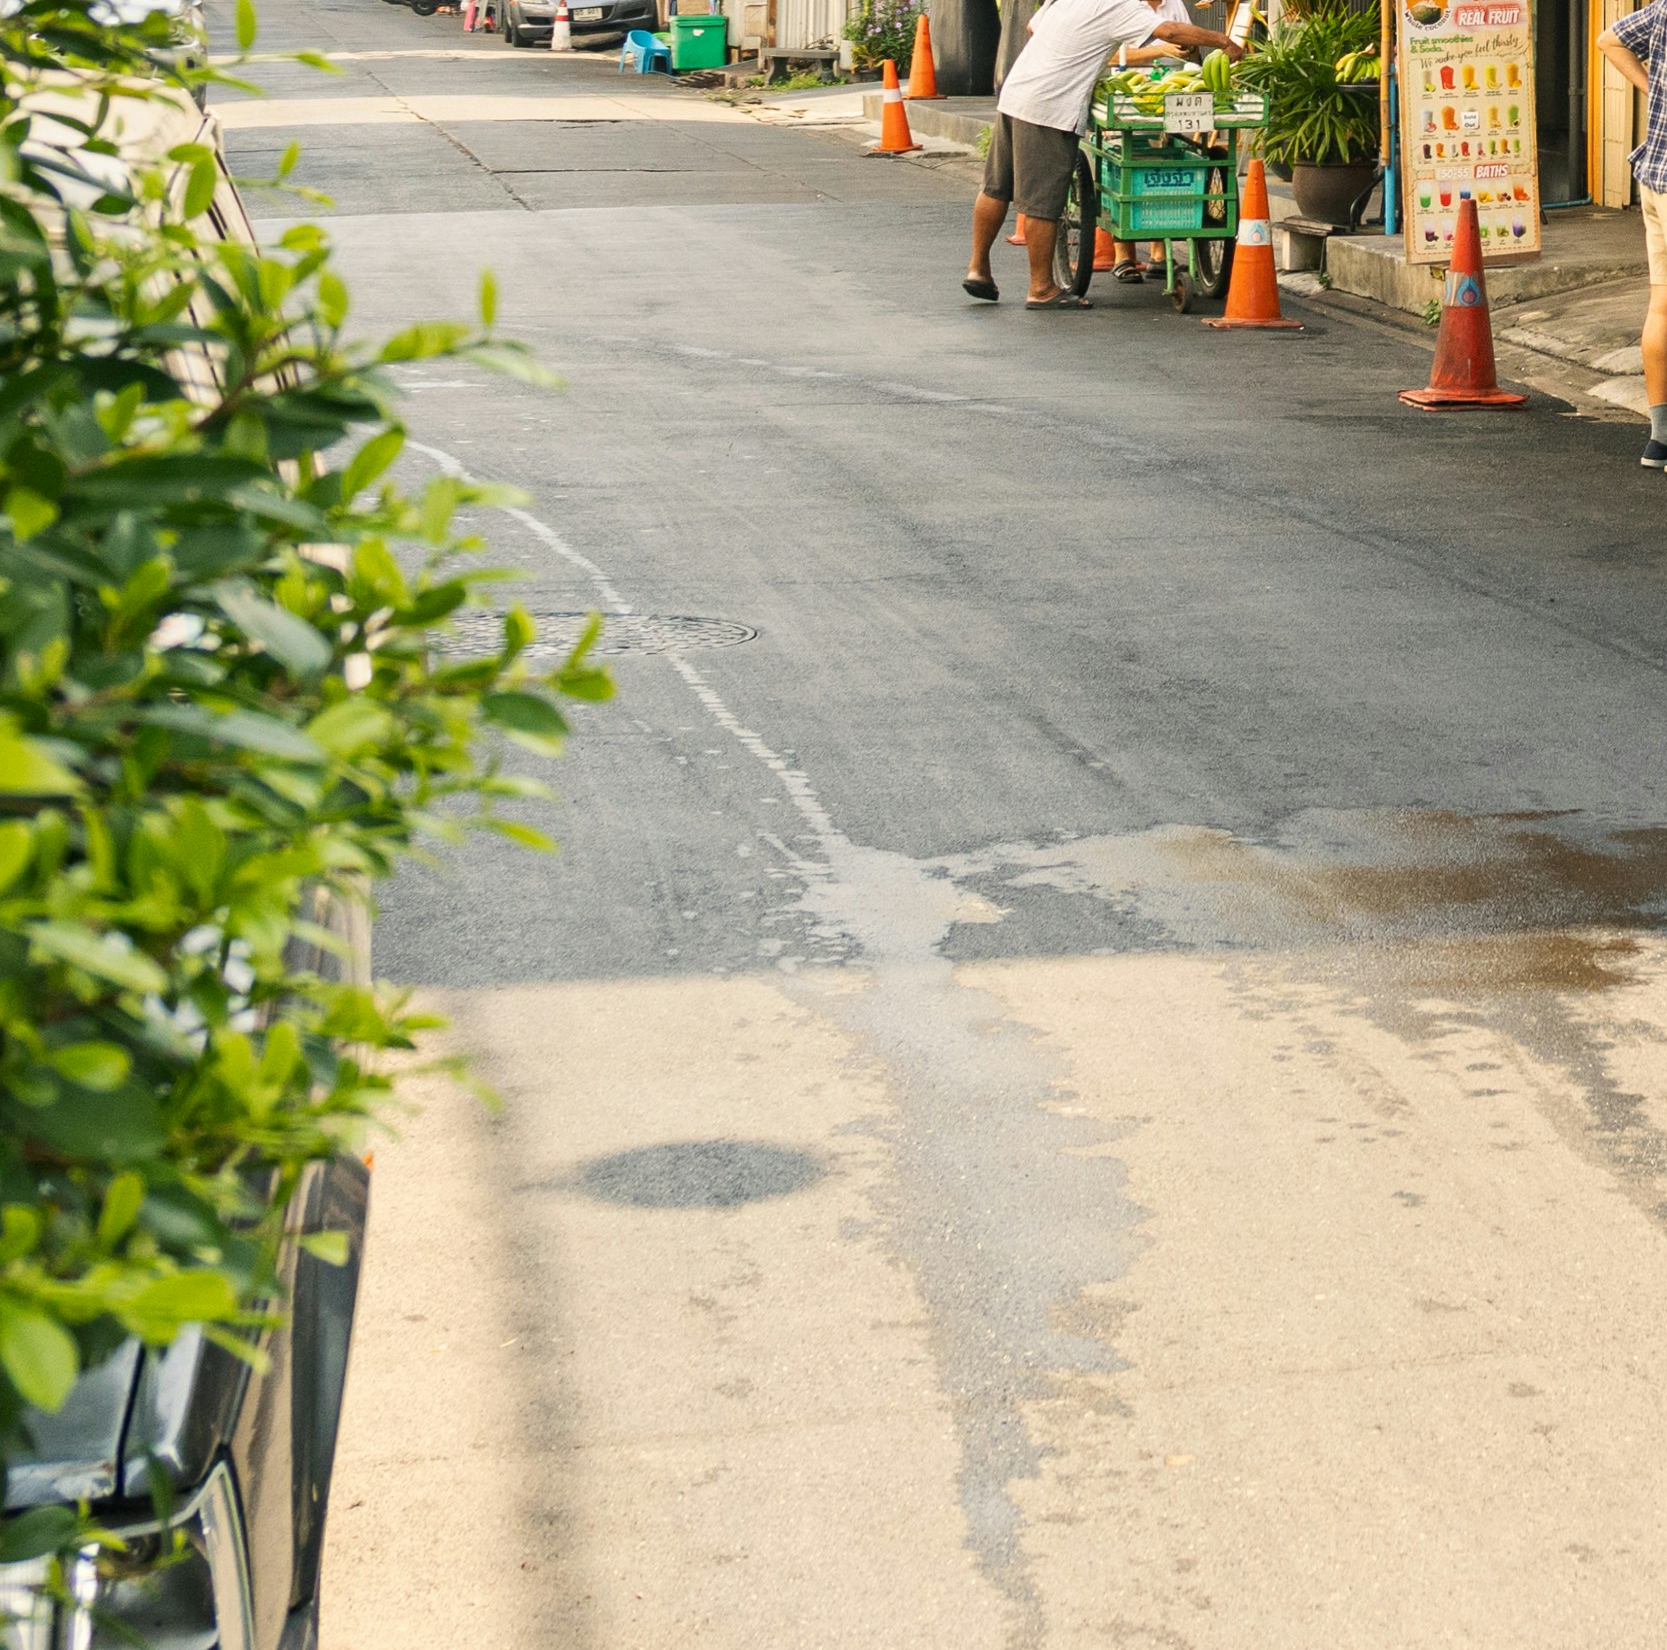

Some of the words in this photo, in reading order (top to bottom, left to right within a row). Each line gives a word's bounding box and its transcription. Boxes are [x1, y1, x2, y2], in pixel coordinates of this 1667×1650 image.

[1458, 8, 1486, 26] REAL
[1488, 7, 1520, 25] FRUIT
[1409, 36, 1430, 45] Fruit
[1431, 34, 1474, 45] smoothies
[1475, 39, 1490, 57] feel
[1491, 34, 1519, 50] thirsty
[1410, 46, 1418, 54] &
[1178, 119, 1201, 130] 131
[1441, 168, 1469, 179] 50-55
[1476, 164, 1509, 179] BATHS
